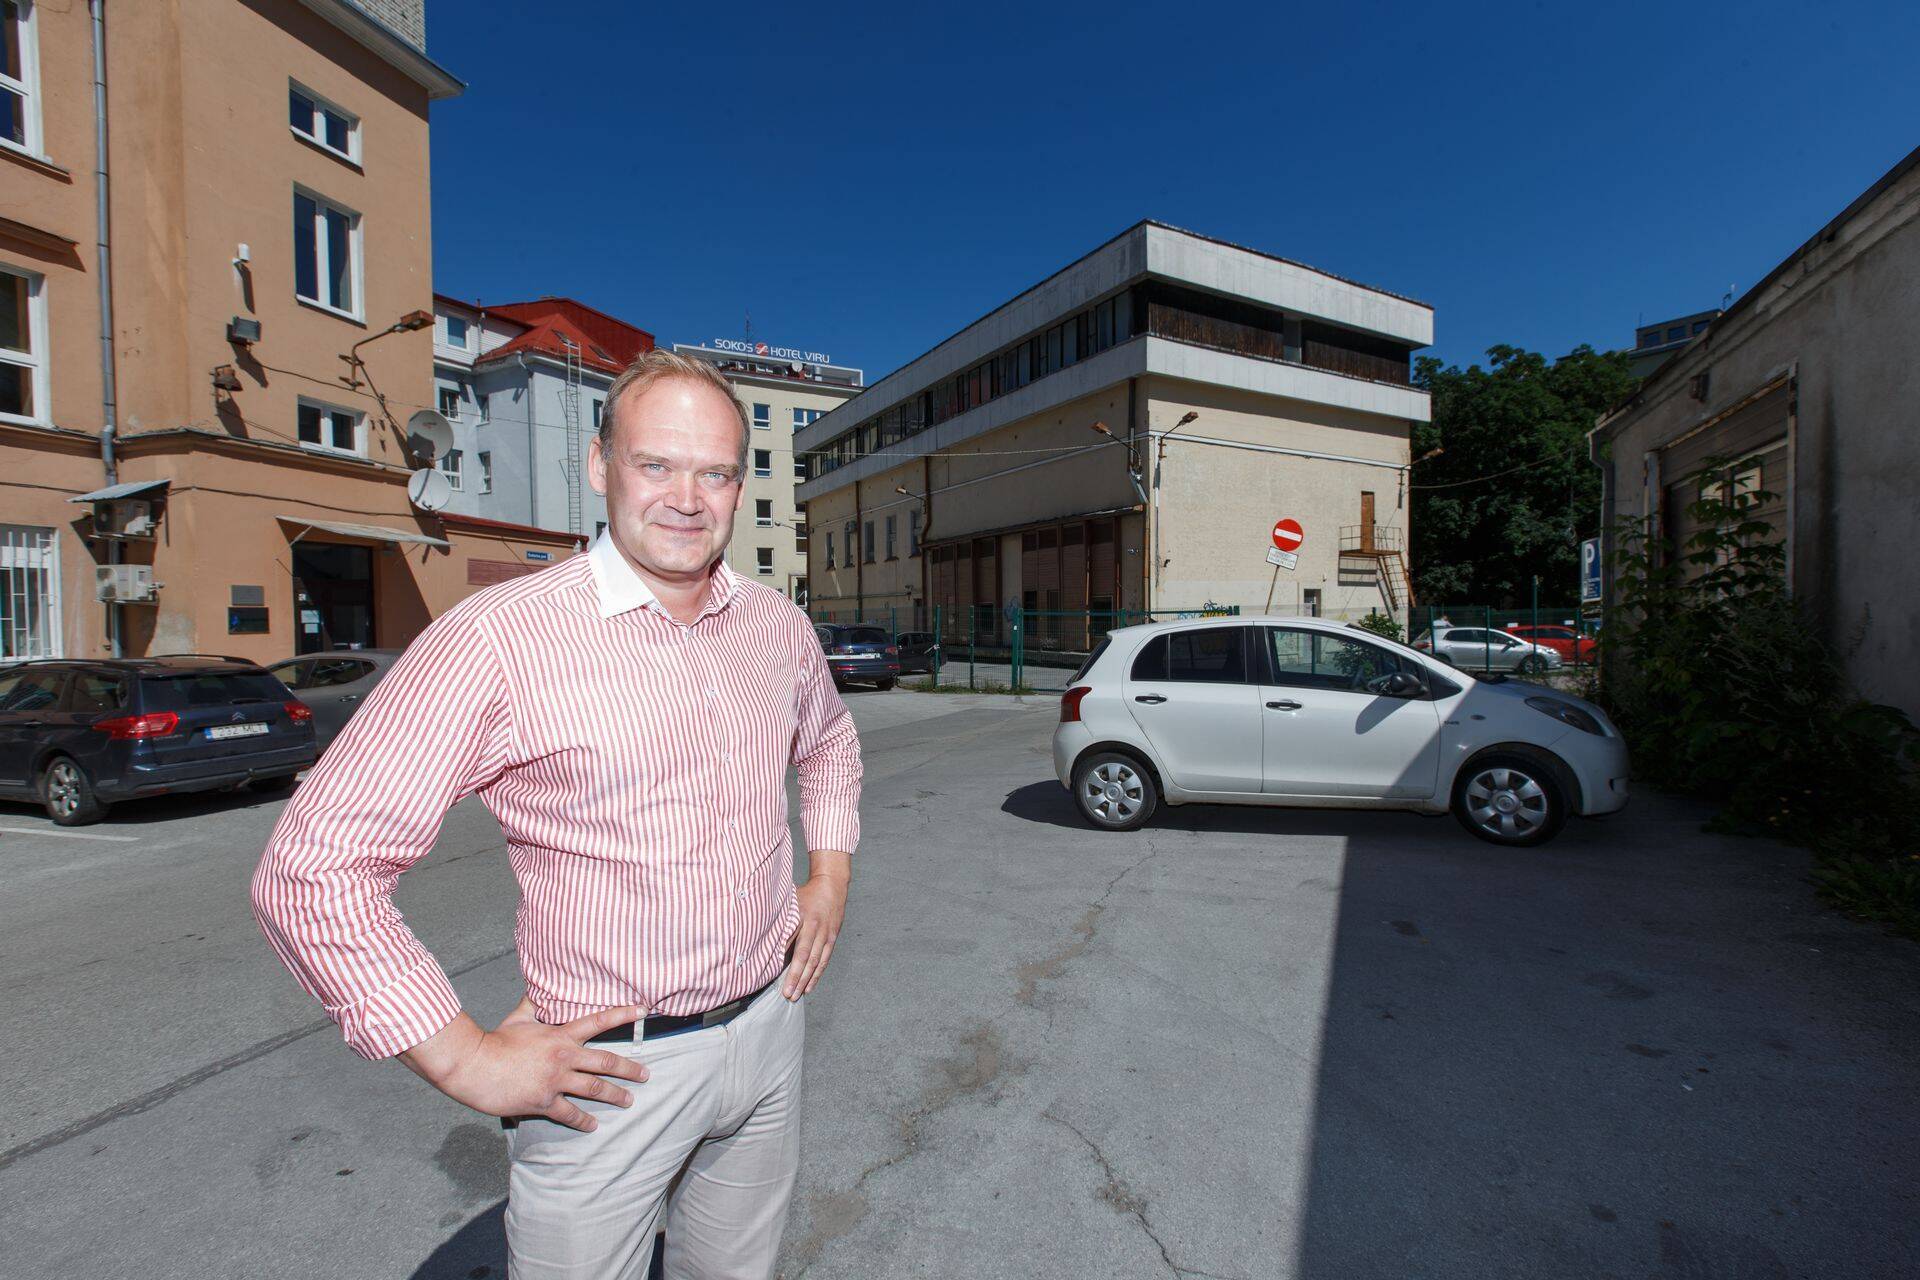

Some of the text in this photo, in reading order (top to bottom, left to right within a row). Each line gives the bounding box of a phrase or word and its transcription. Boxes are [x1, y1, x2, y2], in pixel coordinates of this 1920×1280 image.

[715, 339, 830, 363] SOKOS HOTEL VIRU
[1585, 543, 1595, 574] P
